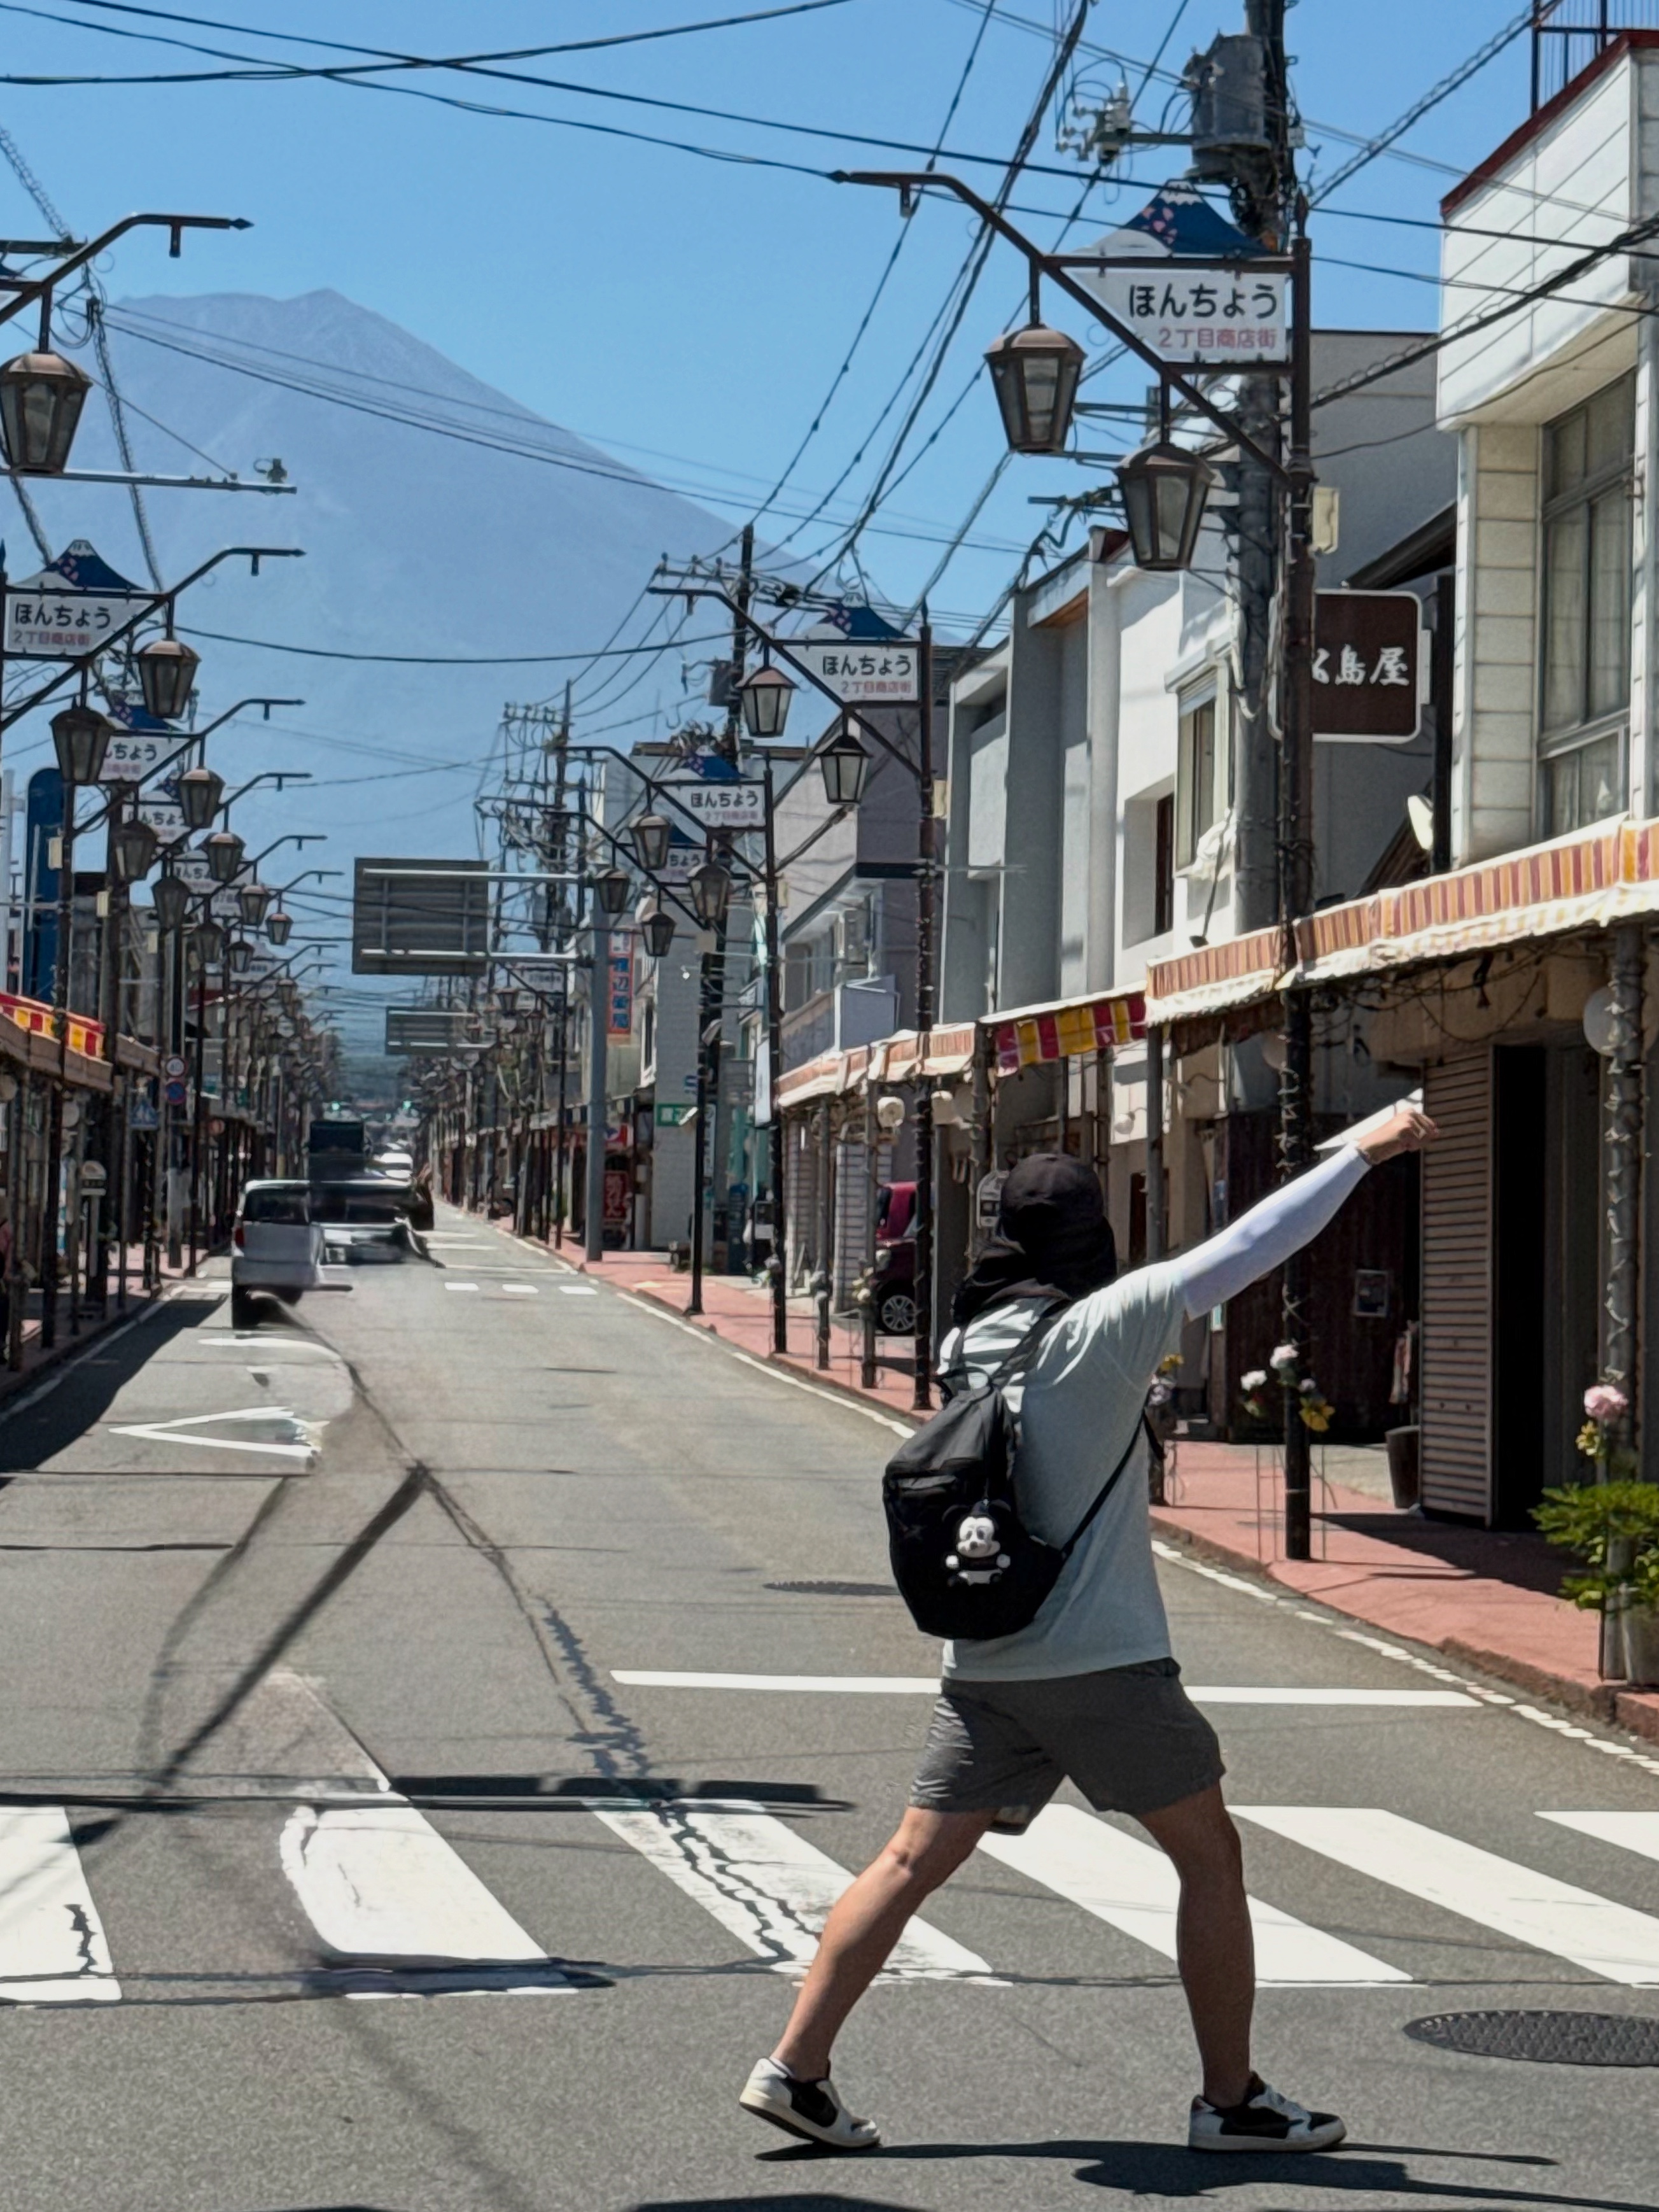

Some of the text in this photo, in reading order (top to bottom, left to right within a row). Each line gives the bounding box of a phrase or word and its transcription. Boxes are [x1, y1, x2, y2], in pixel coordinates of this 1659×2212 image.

[1129, 283, 1277, 319] ほんちょう
[1158, 327, 1277, 348] 2丁目商店街
[15, 603, 111, 629] ほんちょう
[823, 654, 911, 676] ほんちょう
[105, 743, 157, 761] ちょう
[690, 790, 759, 808] ほんちょう
